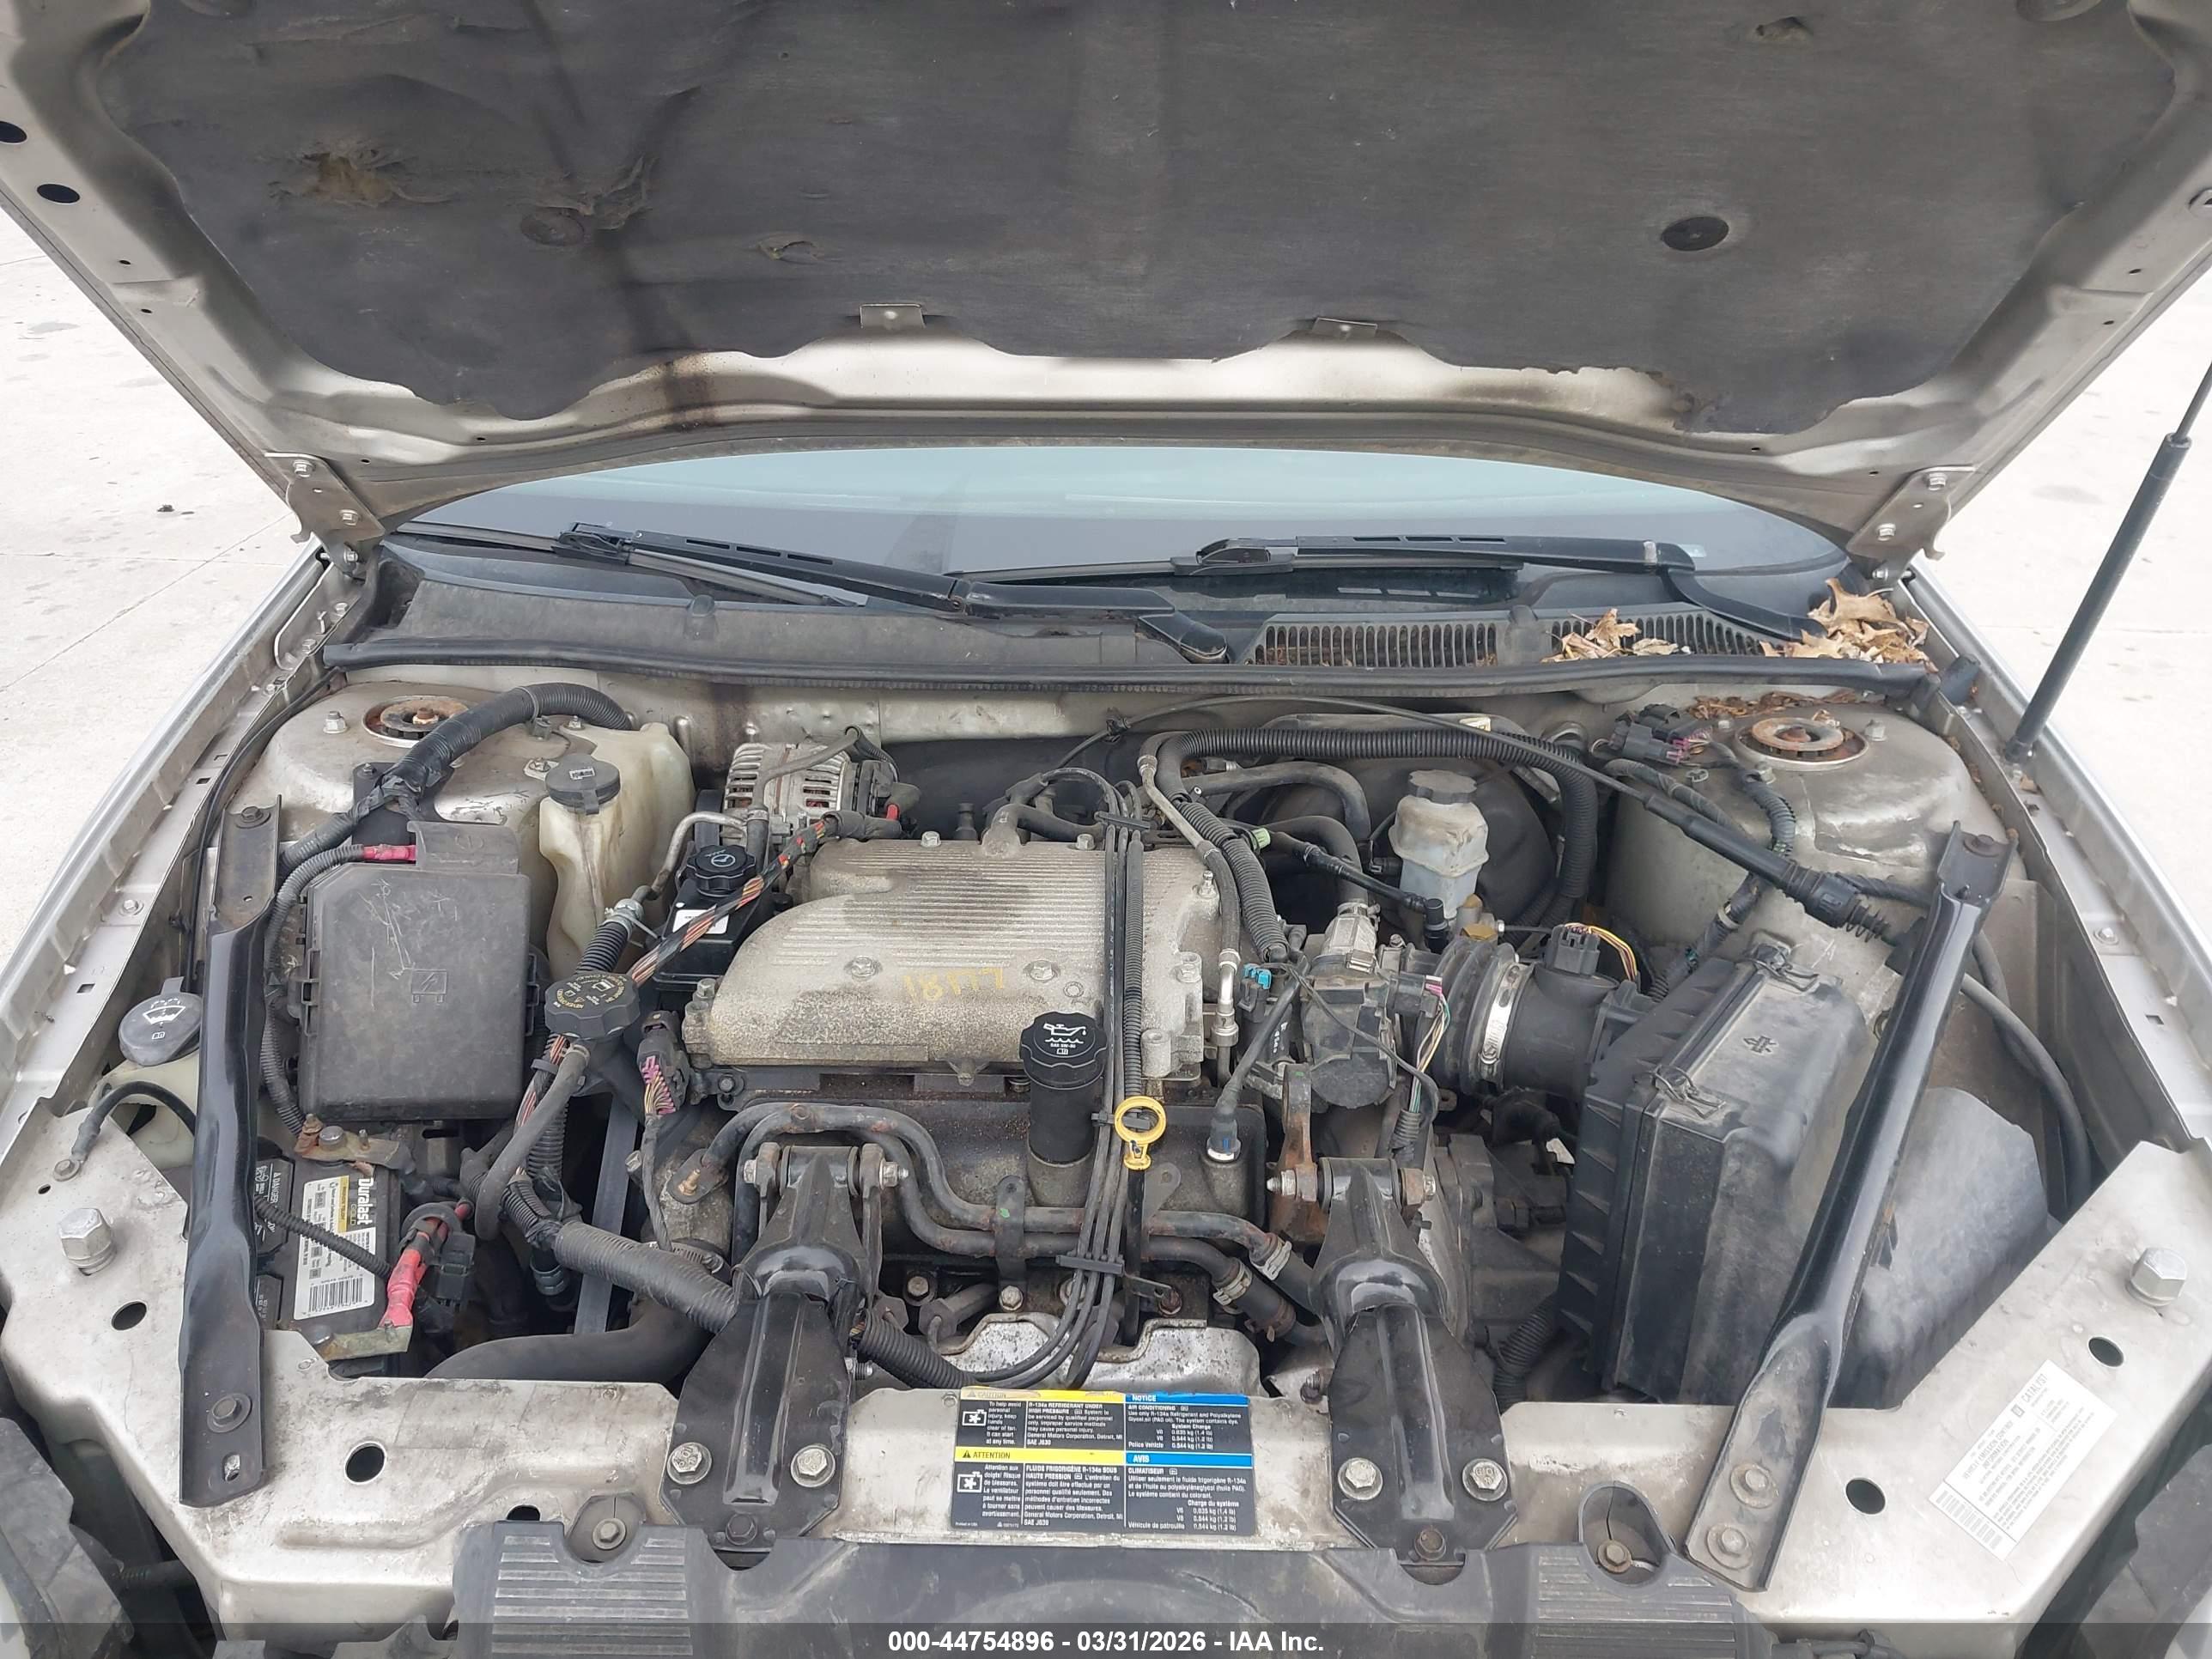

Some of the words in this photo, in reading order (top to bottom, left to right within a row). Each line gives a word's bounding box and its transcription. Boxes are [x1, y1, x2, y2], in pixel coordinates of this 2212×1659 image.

[270, 1178, 280, 1204] DANGER
[357, 1177, 374, 1224] Duralast
[2021, 1372, 2049, 1404] CATALYST
